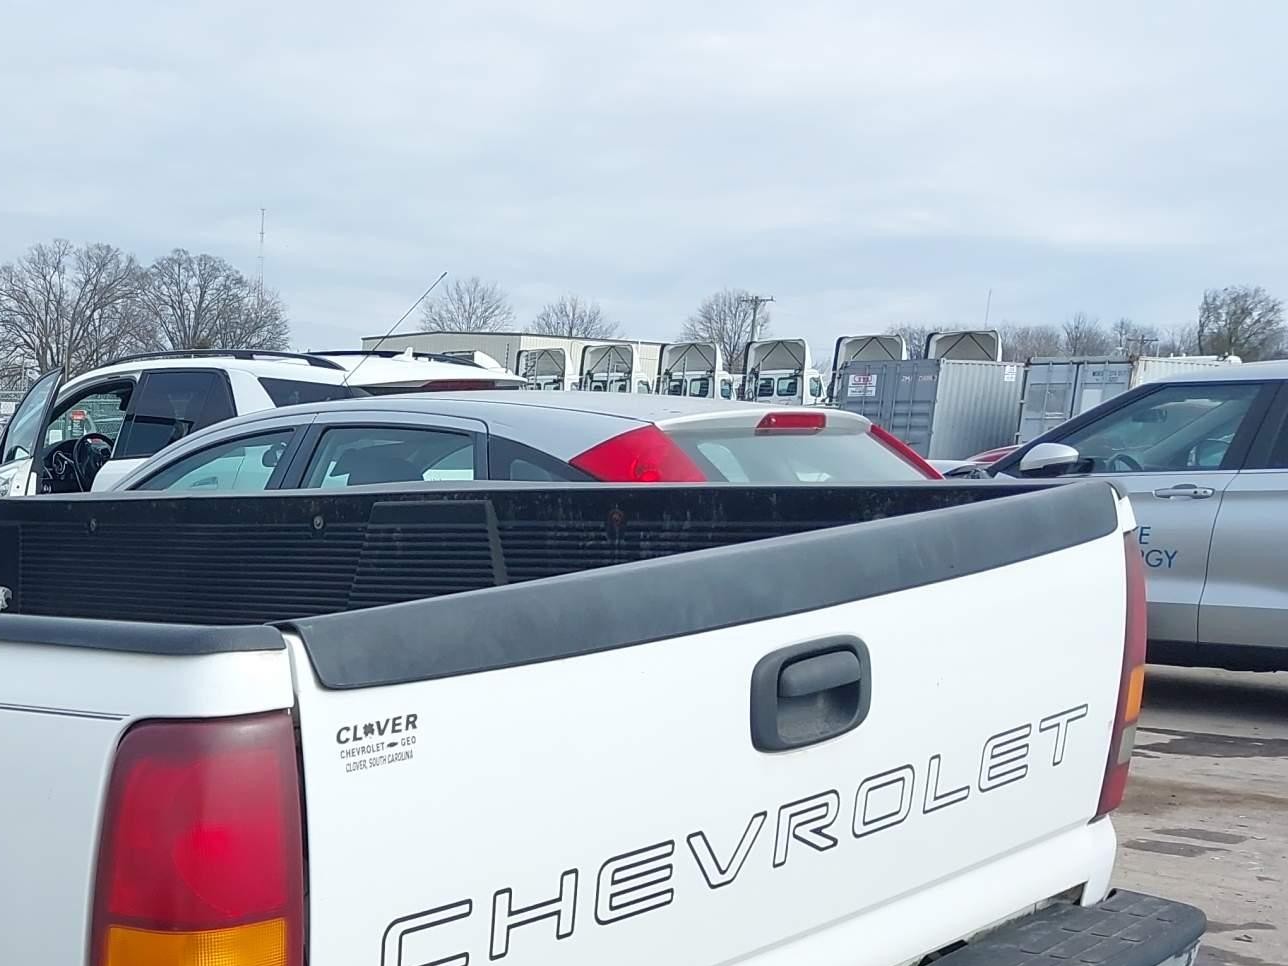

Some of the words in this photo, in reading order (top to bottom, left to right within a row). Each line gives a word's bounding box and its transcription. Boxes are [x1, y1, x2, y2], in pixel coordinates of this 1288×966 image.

[340, 742, 385, 760] CHEVROLET
[400, 735, 417, 747] GEO
[368, 755, 387, 768] SOUTH
[387, 749, 414, 765] CAROLINA
